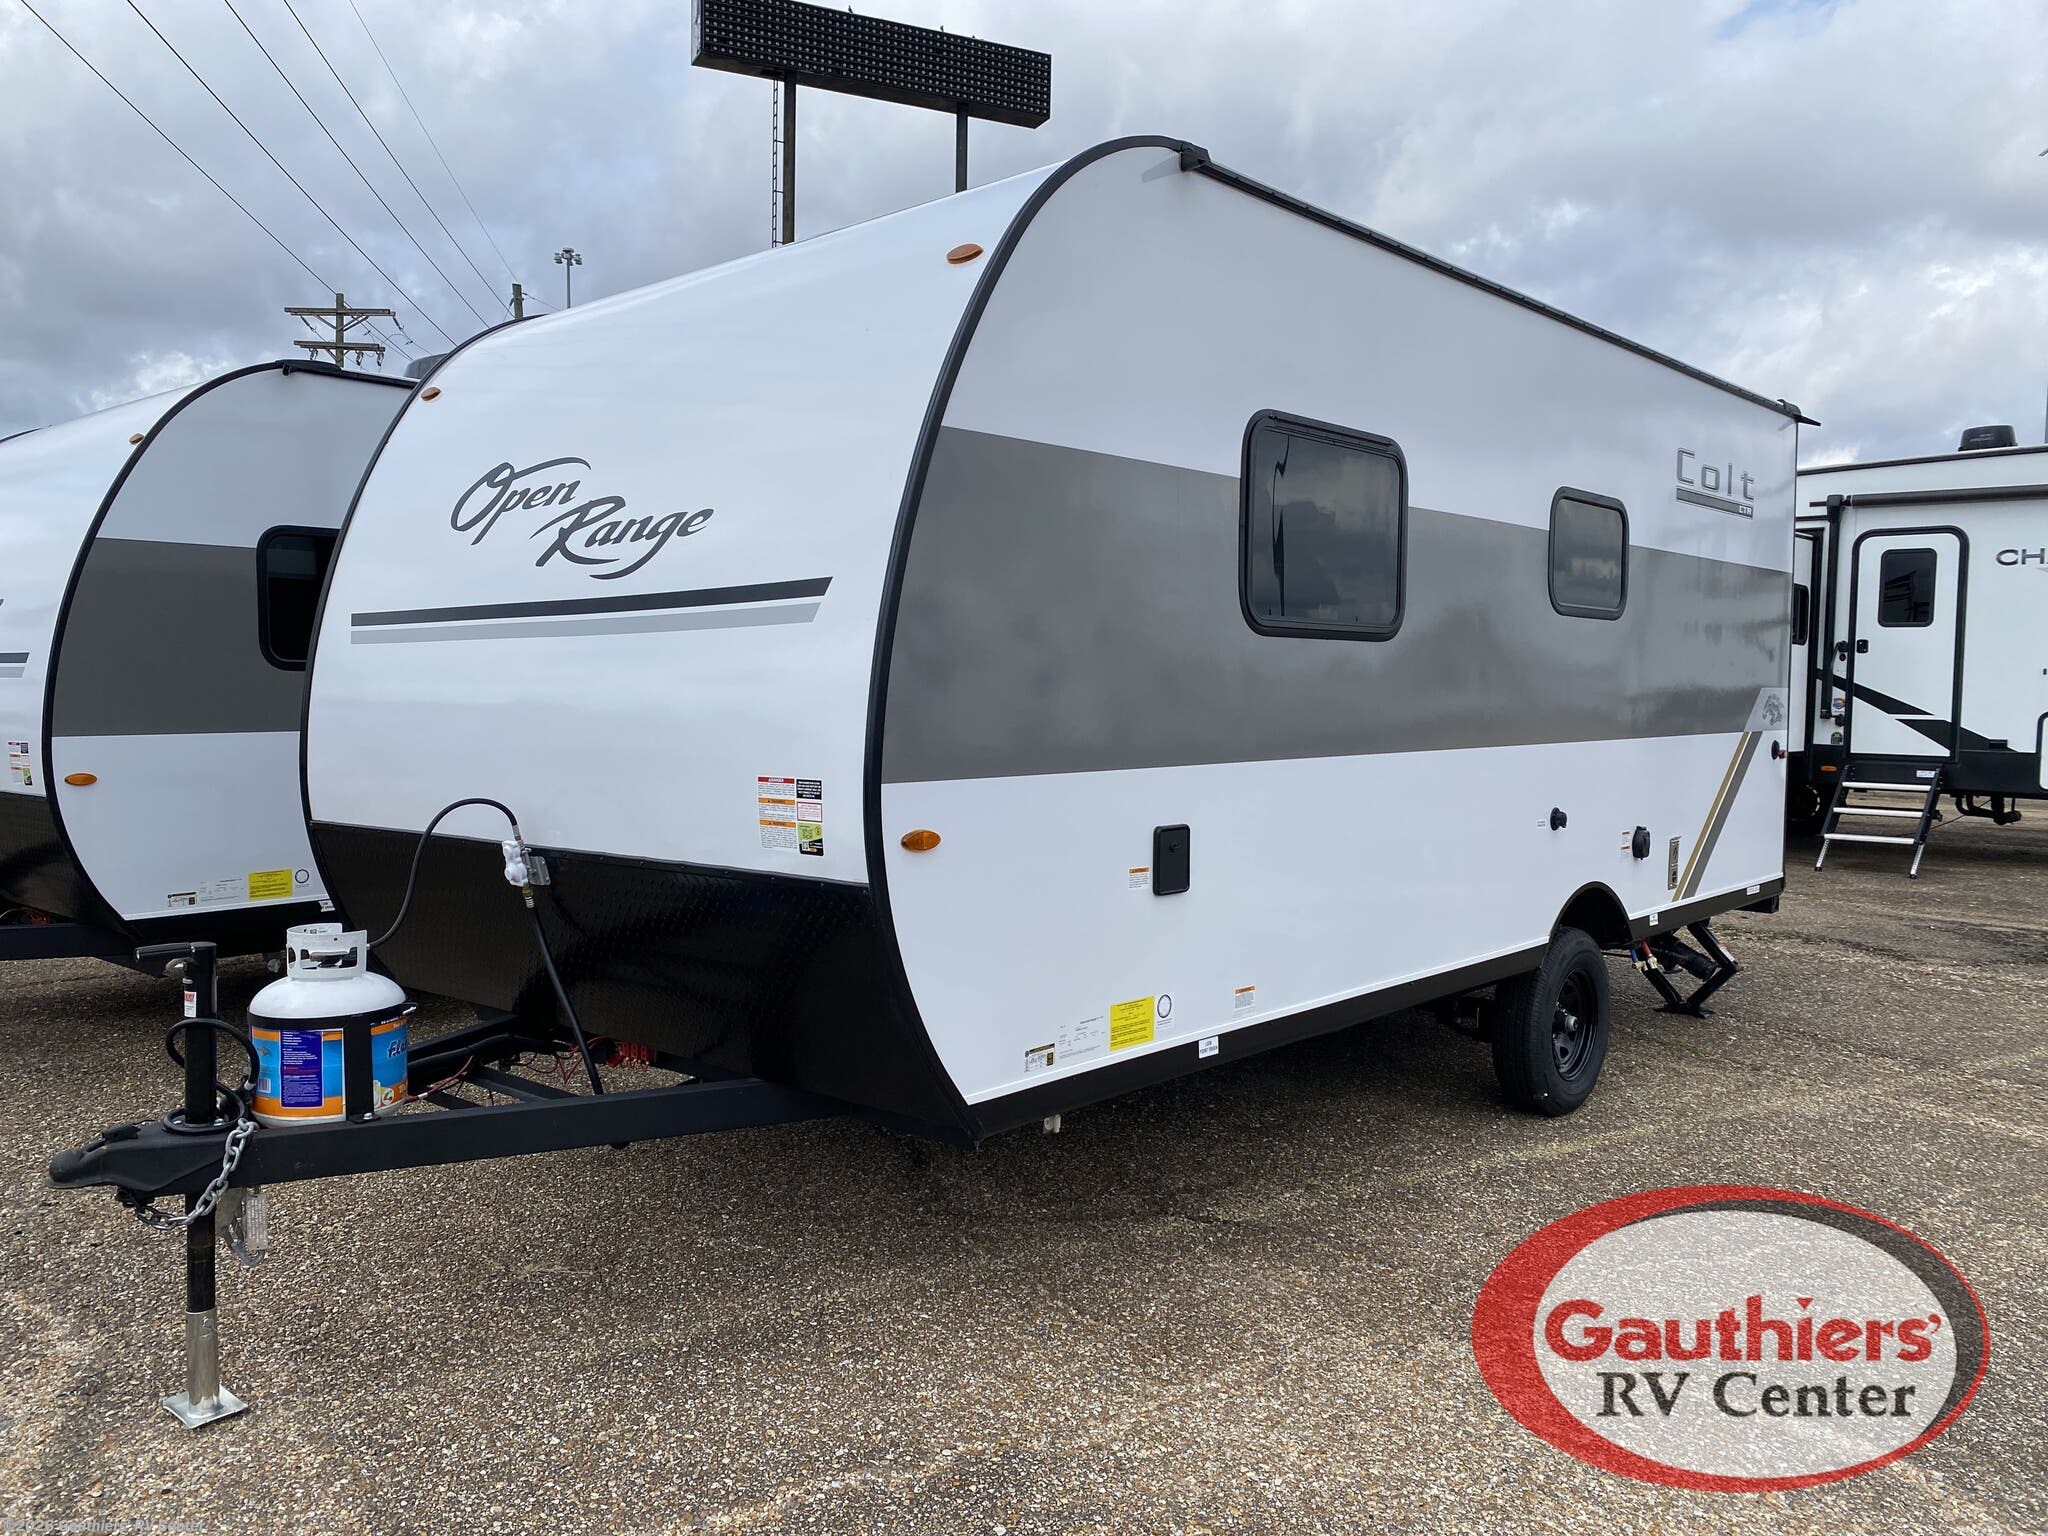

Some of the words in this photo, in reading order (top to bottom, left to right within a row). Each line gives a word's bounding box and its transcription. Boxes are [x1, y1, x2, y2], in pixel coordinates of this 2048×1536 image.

[451, 456, 592, 546] Open
[1676, 448, 1755, 501] Colt
[529, 495, 715, 580] Range
[1996, 547, 2048, 566] CH
